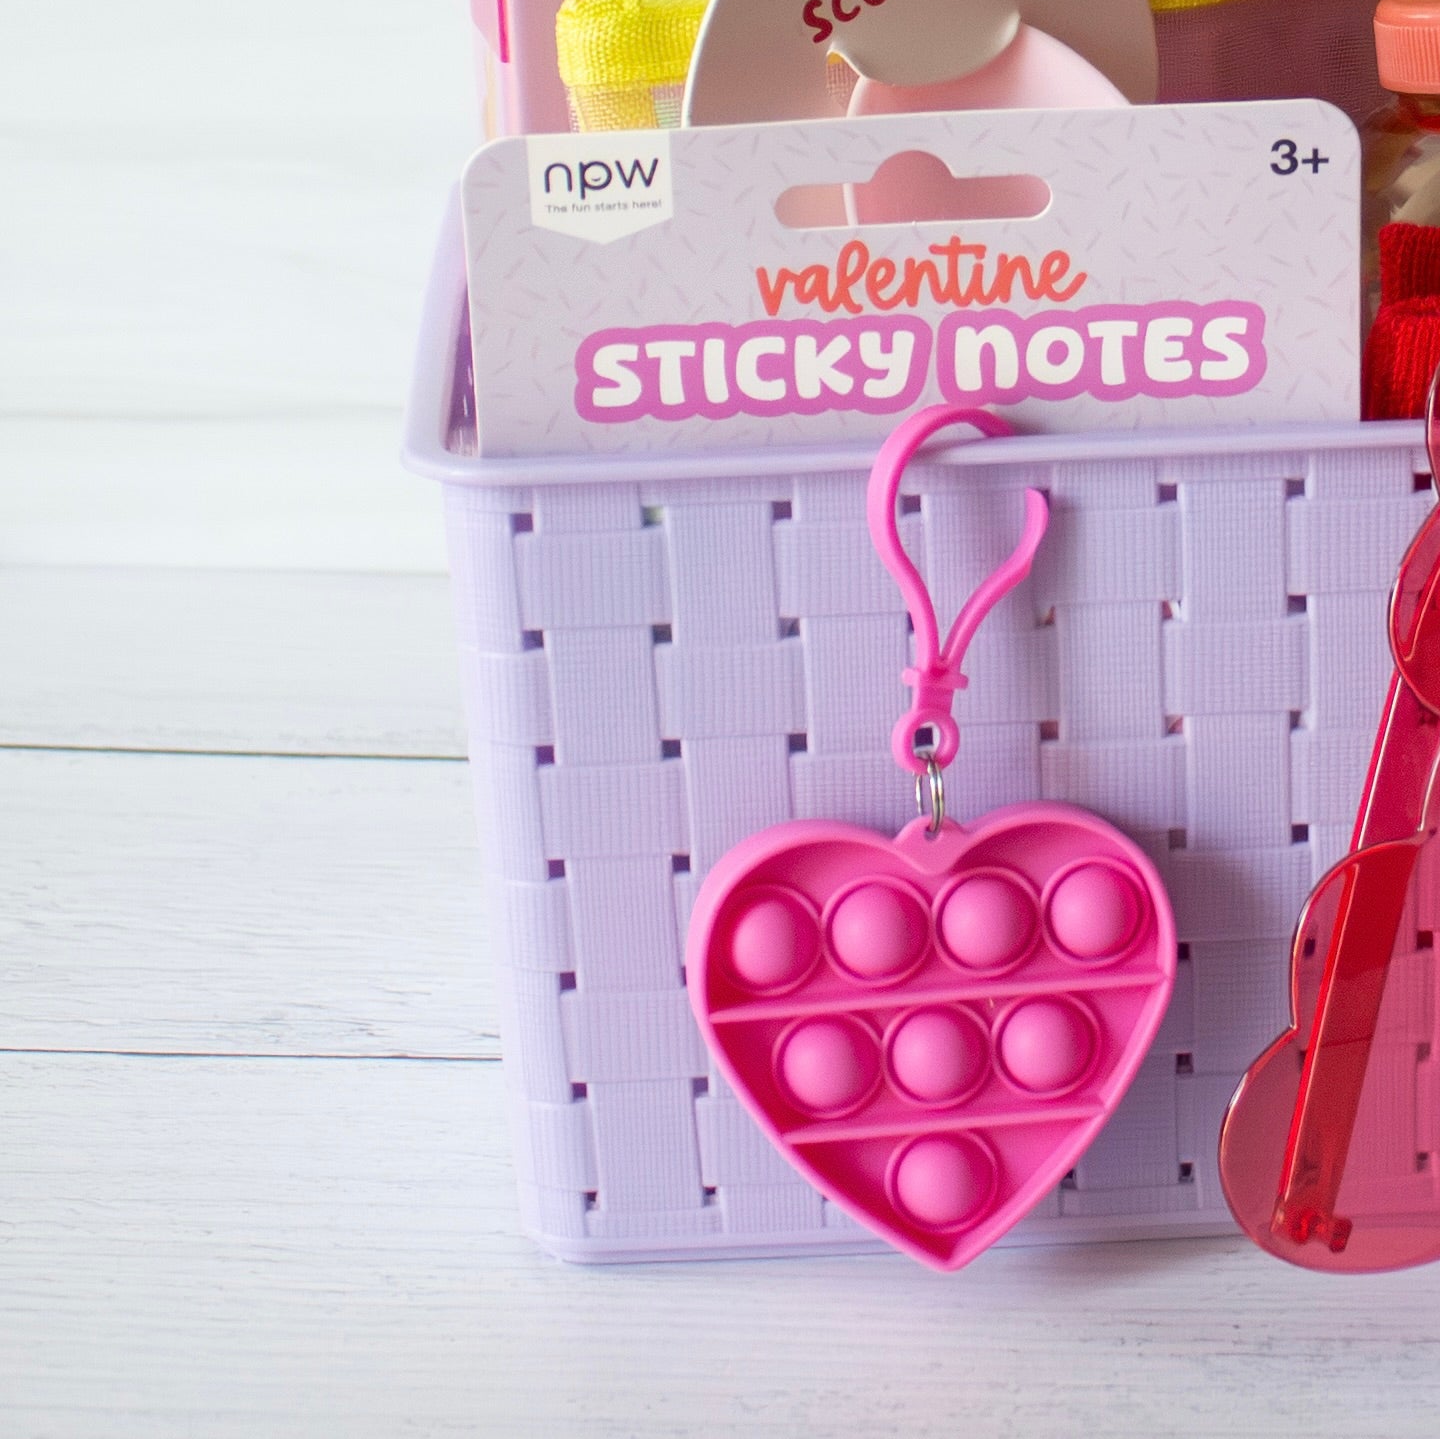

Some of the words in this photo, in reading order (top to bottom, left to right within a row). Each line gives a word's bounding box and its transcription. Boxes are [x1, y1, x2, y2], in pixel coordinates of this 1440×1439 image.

[544, 157, 659, 201] npw
[1269, 138, 1330, 176] 3+
[546, 204, 568, 214] The
[571, 202, 591, 213] fun
[595, 200, 628, 212] starts
[632, 198, 663, 210] here!
[756, 235, 1088, 317] valentine
[592, 329, 916, 408] STICKY
